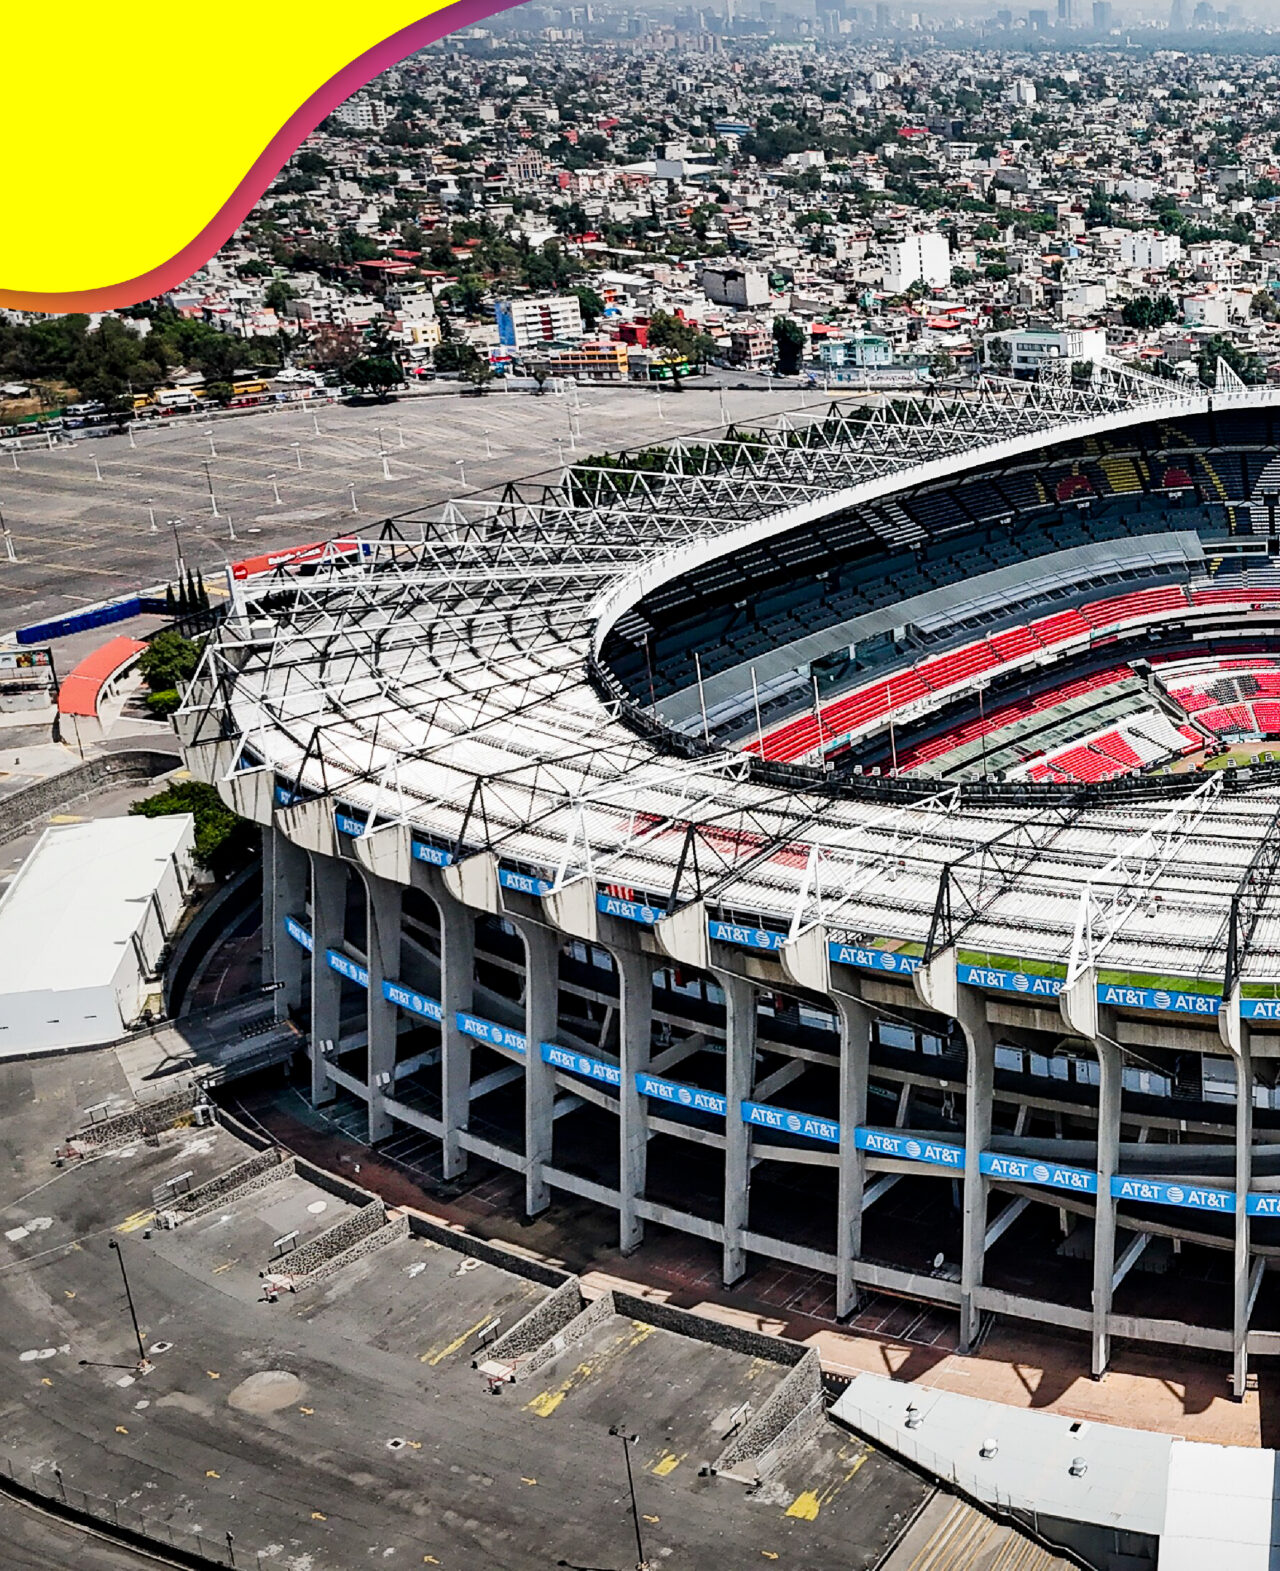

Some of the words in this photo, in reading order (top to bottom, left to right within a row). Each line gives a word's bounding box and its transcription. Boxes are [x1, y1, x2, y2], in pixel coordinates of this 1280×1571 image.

[420, 846, 442, 864] AT&T
[506, 874, 533, 891] AT&T
[606, 899, 636, 918] AT&T
[716, 926, 750, 943] AT&T
[839, 948, 875, 965] AT&T
[968, 971, 1006, 987] AT&T
[1033, 979, 1064, 994] AT&
[390, 987, 410, 1005] AT&T
[1105, 988, 1147, 1005] AT&T
[1175, 996, 1217, 1012] AT&T
[464, 1020, 488, 1037] AT&T
[549, 1049, 574, 1067] AT&T
[593, 1064, 620, 1081] AT&T
[645, 1080, 673, 1098] AT&T
[694, 1093, 725, 1111] AT&T
[751, 1107, 781, 1125] AT&T
[804, 1120, 837, 1138] AT&T
[866, 1134, 900, 1152] AT&T
[925, 1146, 960, 1163] AT&T
[991, 1159, 1027, 1177] AT&T
[1053, 1170, 1091, 1188] AT&T
[1121, 1182, 1160, 1200] AT&T
[1188, 1191, 1229, 1208] AT&T
